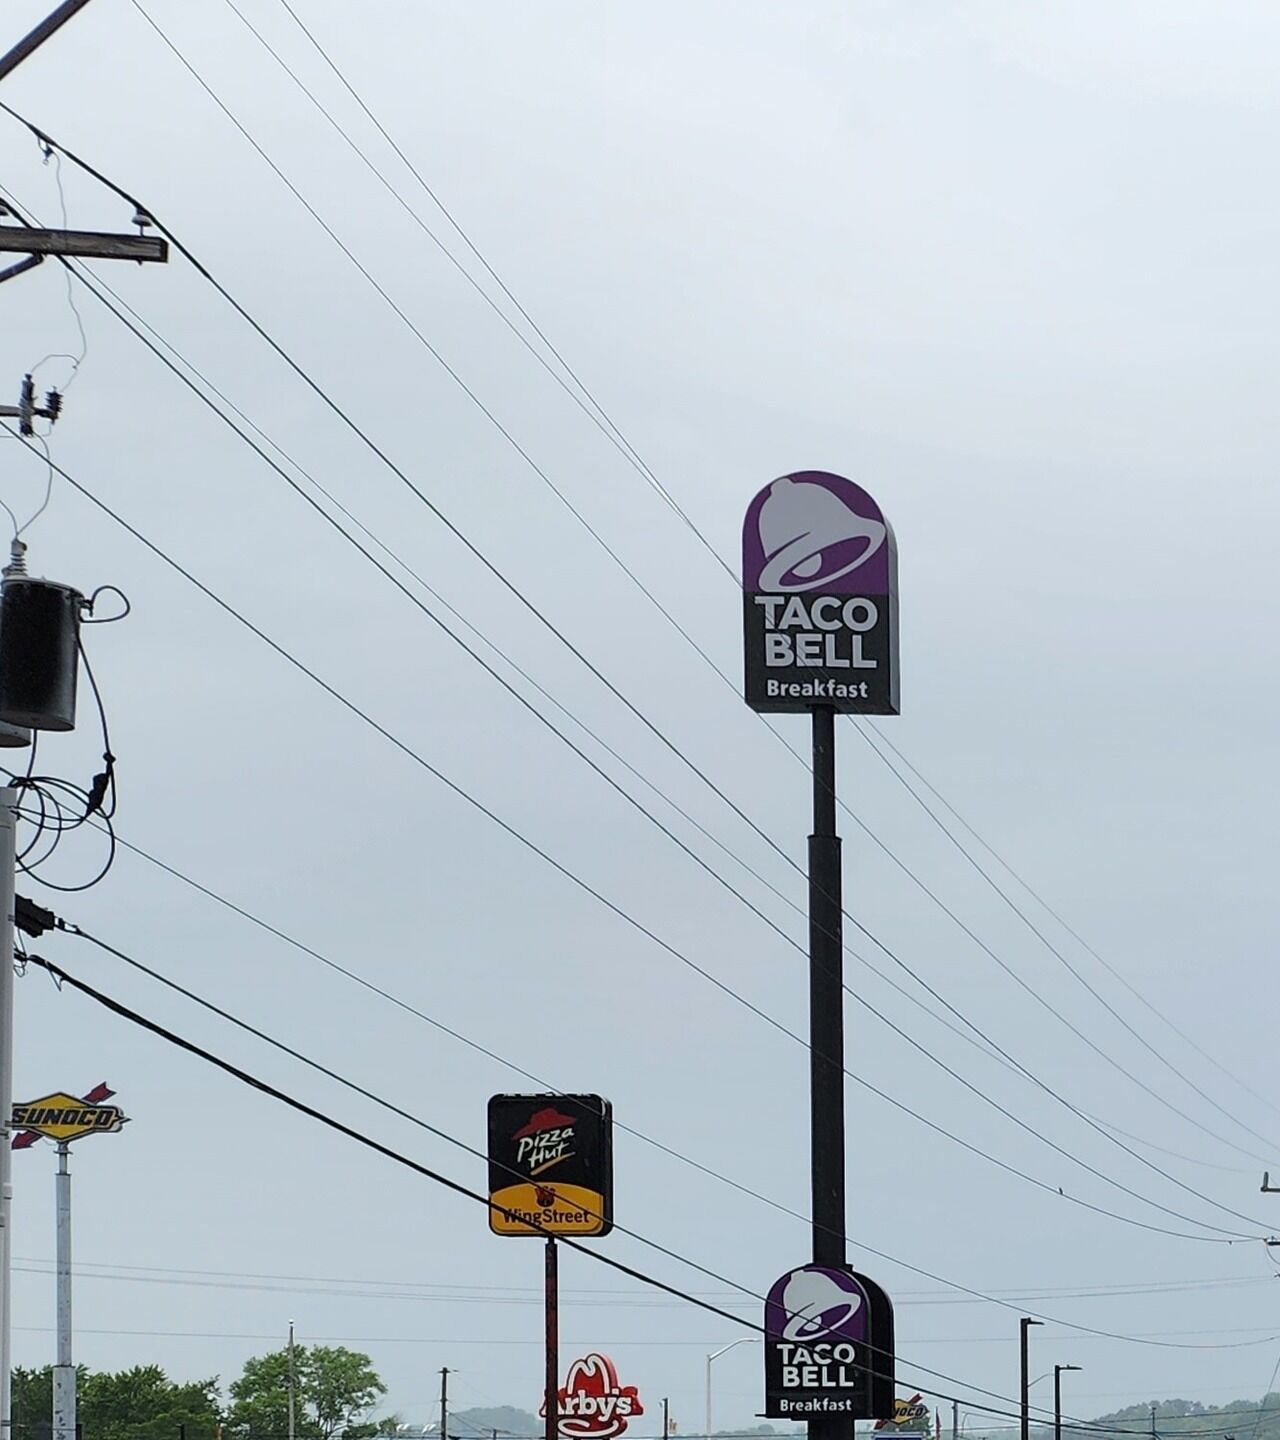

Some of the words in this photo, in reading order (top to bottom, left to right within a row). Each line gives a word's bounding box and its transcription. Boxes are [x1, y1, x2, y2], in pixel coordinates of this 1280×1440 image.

[754, 595, 878, 632] TACO
[765, 633, 877, 669] BELL
[767, 679, 868, 698] Breakfast
[12, 1108, 114, 1126] SUNOCO
[517, 1127, 575, 1163] Pizza
[528, 1142, 569, 1168] Hut
[503, 1208, 590, 1226] WingStreet
[776, 1343, 855, 1365] TACO
[783, 1366, 854, 1387] BELL
[780, 1399, 852, 1412] Breakfast
